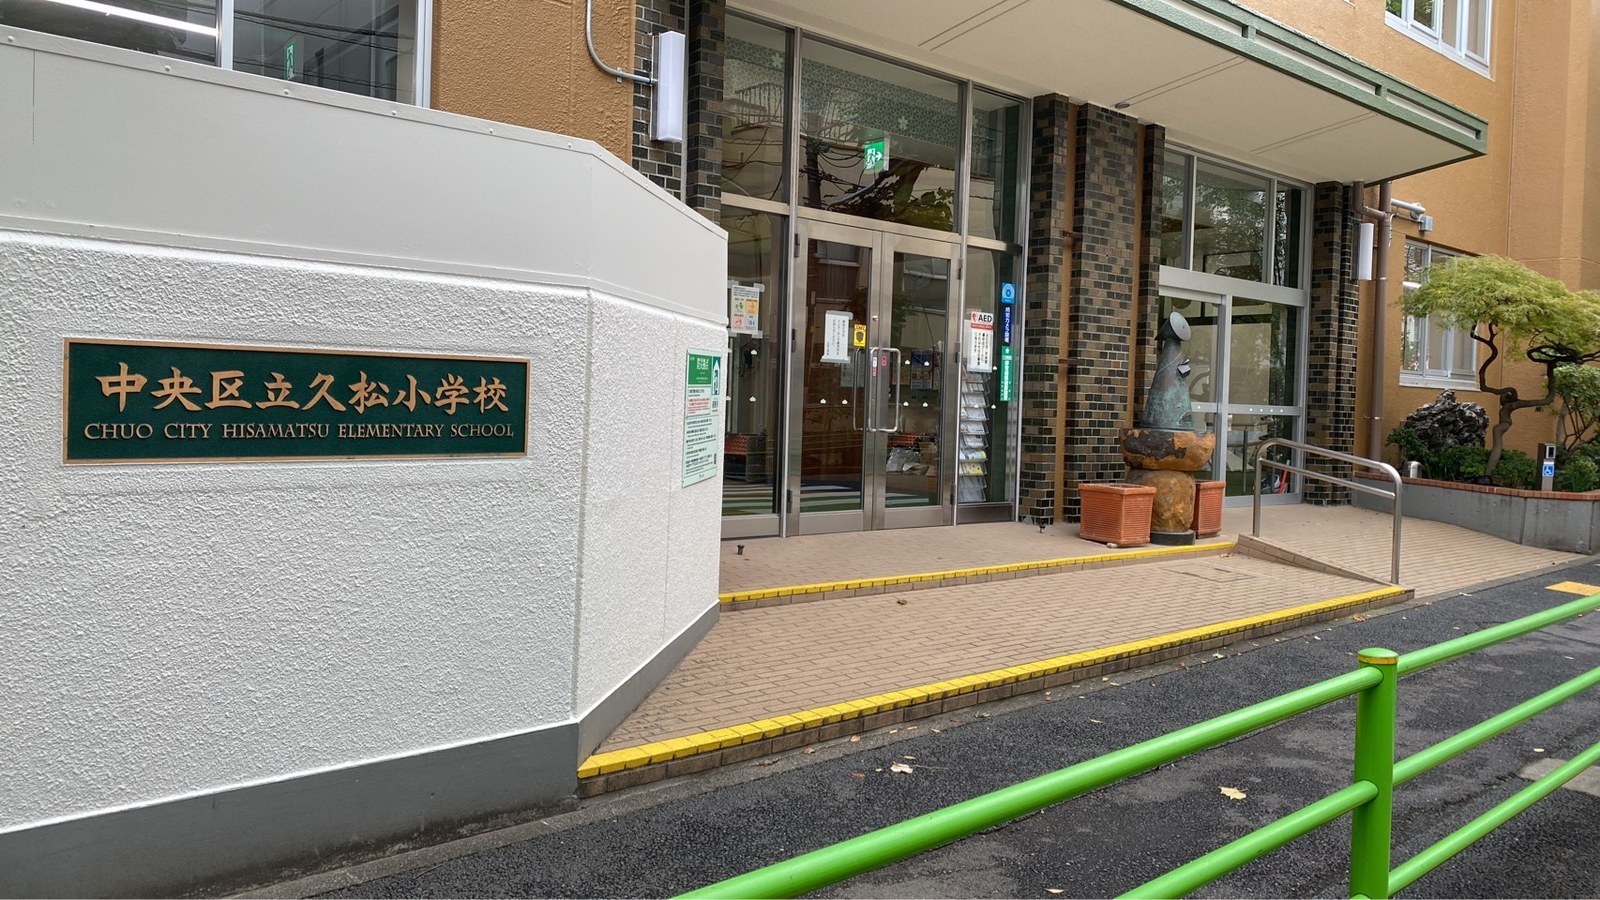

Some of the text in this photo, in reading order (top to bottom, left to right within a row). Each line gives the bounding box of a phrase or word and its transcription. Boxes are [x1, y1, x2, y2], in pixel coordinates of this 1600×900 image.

[978, 314, 992, 323] AED
[95, 362, 509, 415] 中央区立久松小学校
[84, 423, 514, 440] CHUO CITY HISAMATSU ELEMENTARY SCHOOL
